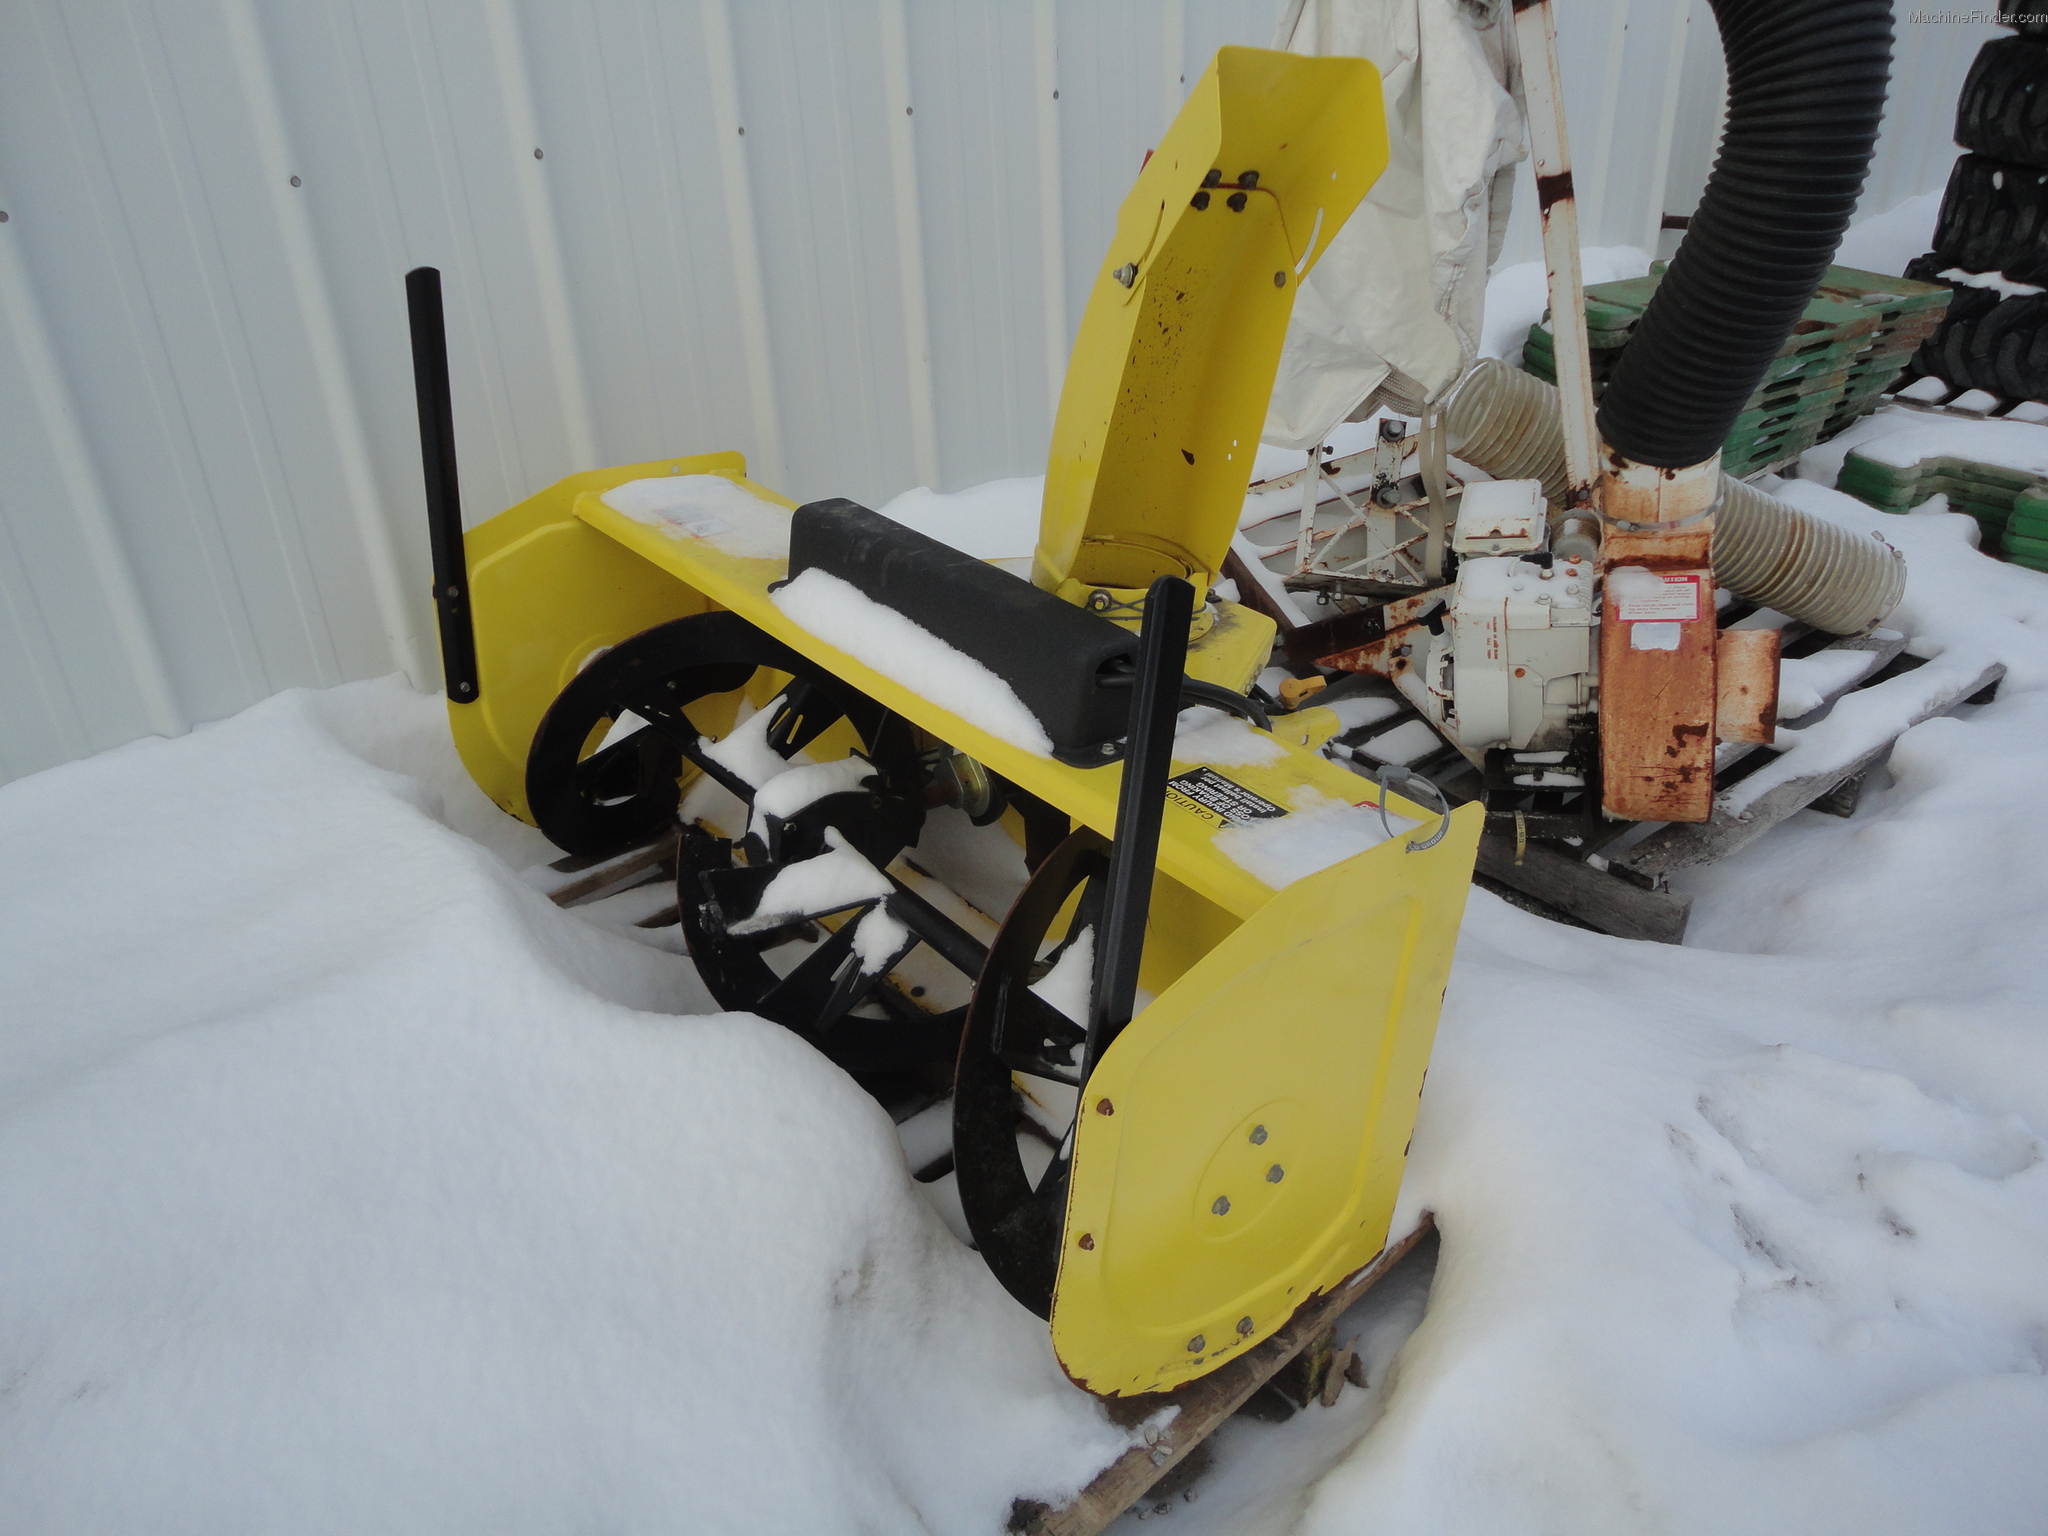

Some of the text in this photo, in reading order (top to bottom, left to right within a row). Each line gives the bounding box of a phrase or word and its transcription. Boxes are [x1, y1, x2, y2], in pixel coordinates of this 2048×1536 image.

[1168, 781, 1195, 795] FROM
[1179, 780, 1250, 819] OSS OF BRAKING
[1192, 795, 1226, 812] INJURY
[1195, 782, 1252, 814] OR STEERING
[1200, 776, 1267, 813] Install ballast per
[1204, 772, 1276, 812] Operator's Manual
[1420, 831, 1443, 849] GROUP
